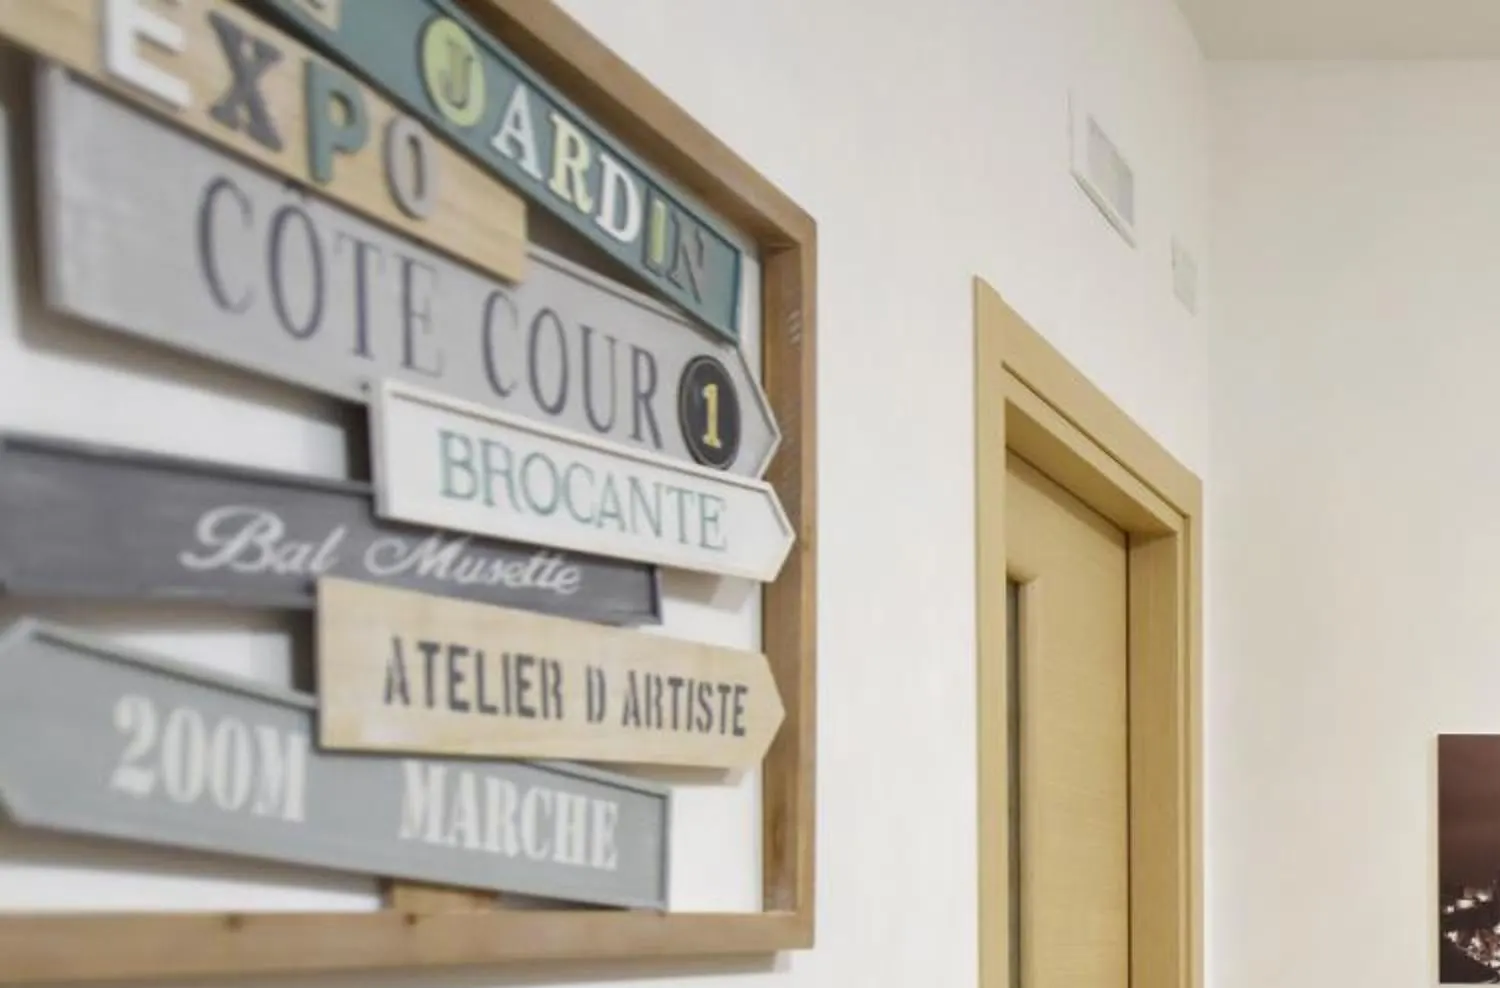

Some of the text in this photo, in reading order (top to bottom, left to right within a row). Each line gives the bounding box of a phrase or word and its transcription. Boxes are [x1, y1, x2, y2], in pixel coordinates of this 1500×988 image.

[103, 0, 440, 222] EXPO
[416, 12, 704, 304] JARDIN
[482, 289, 663, 450] COUR
[178, 503, 583, 596] Bal Musette
[437, 429, 728, 551] BROCANTE
[383, 634, 749, 737] ATELIER D ARTISTE
[108, 694, 308, 823] 200M
